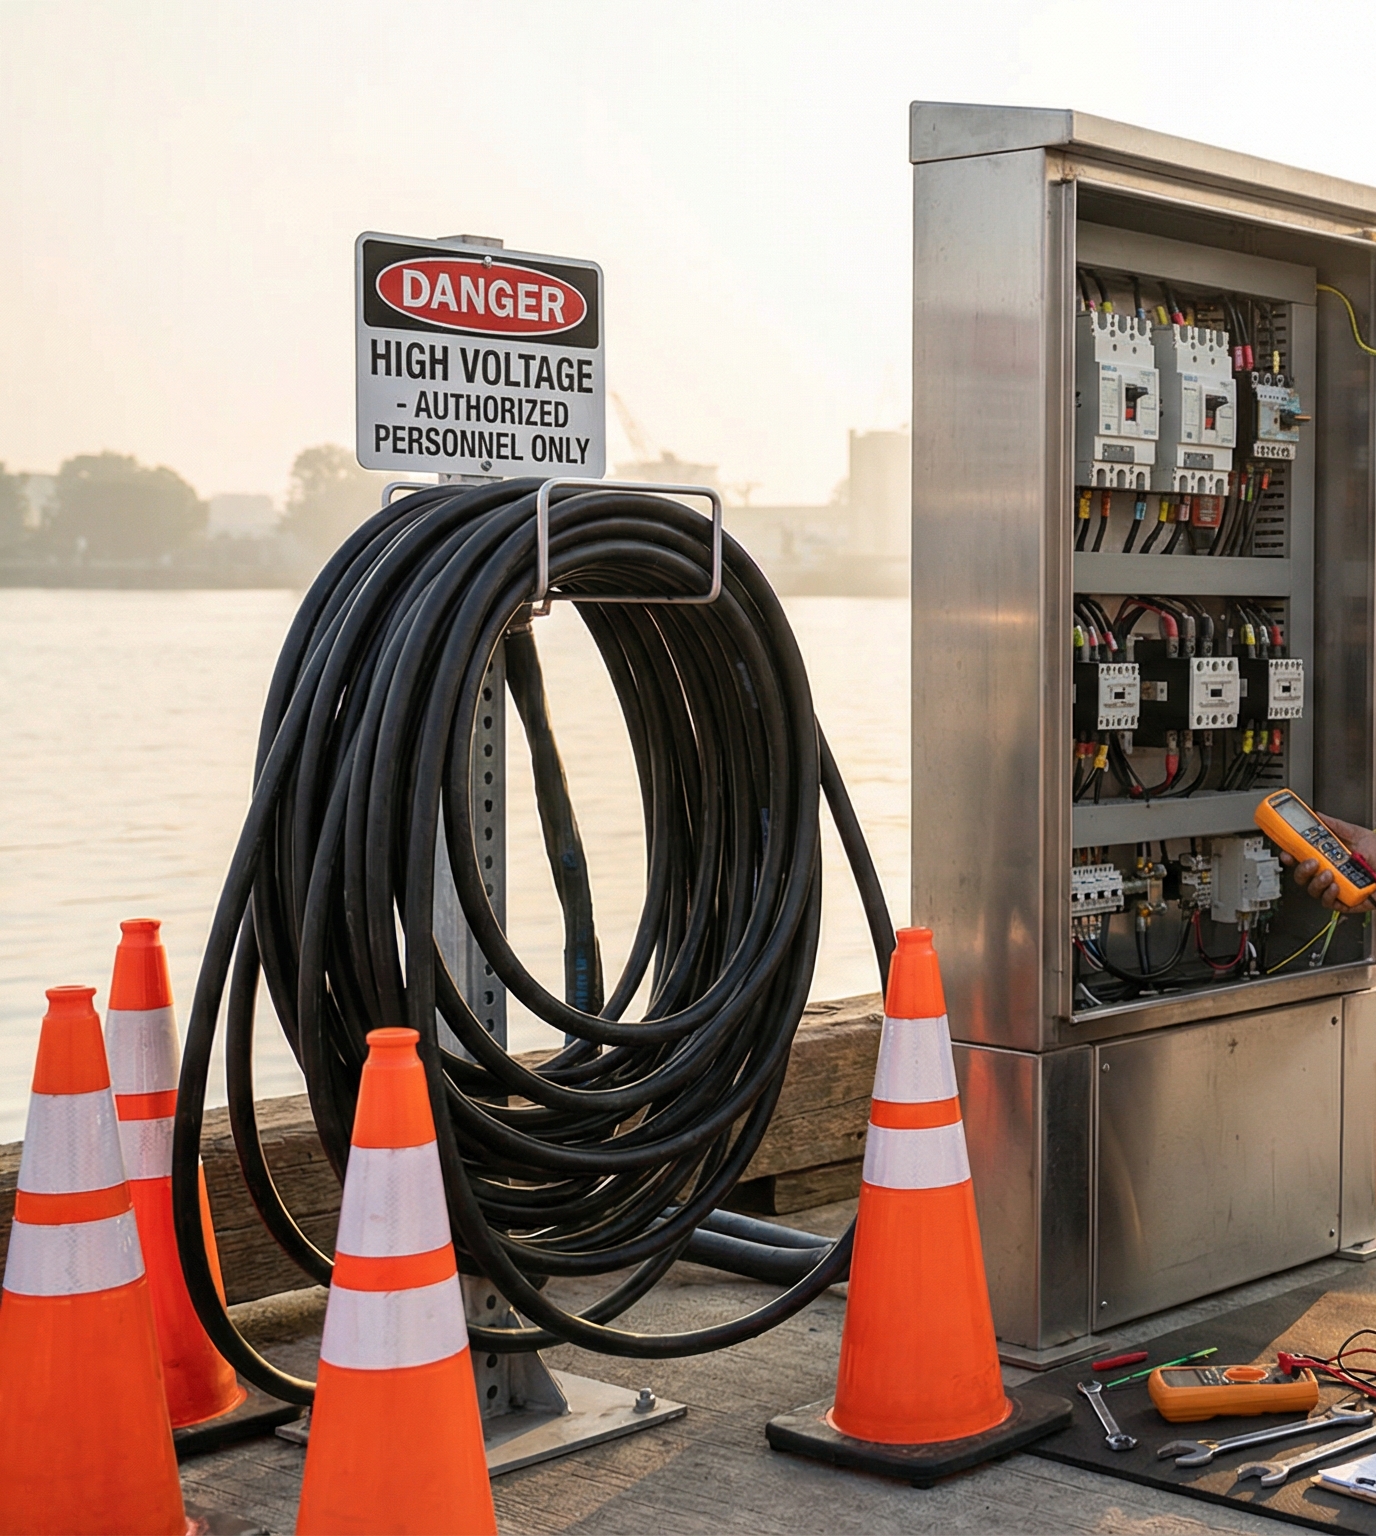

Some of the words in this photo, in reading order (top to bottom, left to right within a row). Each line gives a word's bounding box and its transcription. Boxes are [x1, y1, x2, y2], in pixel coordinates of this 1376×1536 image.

[402, 268, 566, 324] DANGER
[370, 338, 449, 381] HIGH
[459, 346, 594, 394] VOLTAGE
[414, 390, 569, 428] AUTHORIZED
[374, 423, 524, 460] PERSONNEL
[531, 434, 590, 465] ONLY
